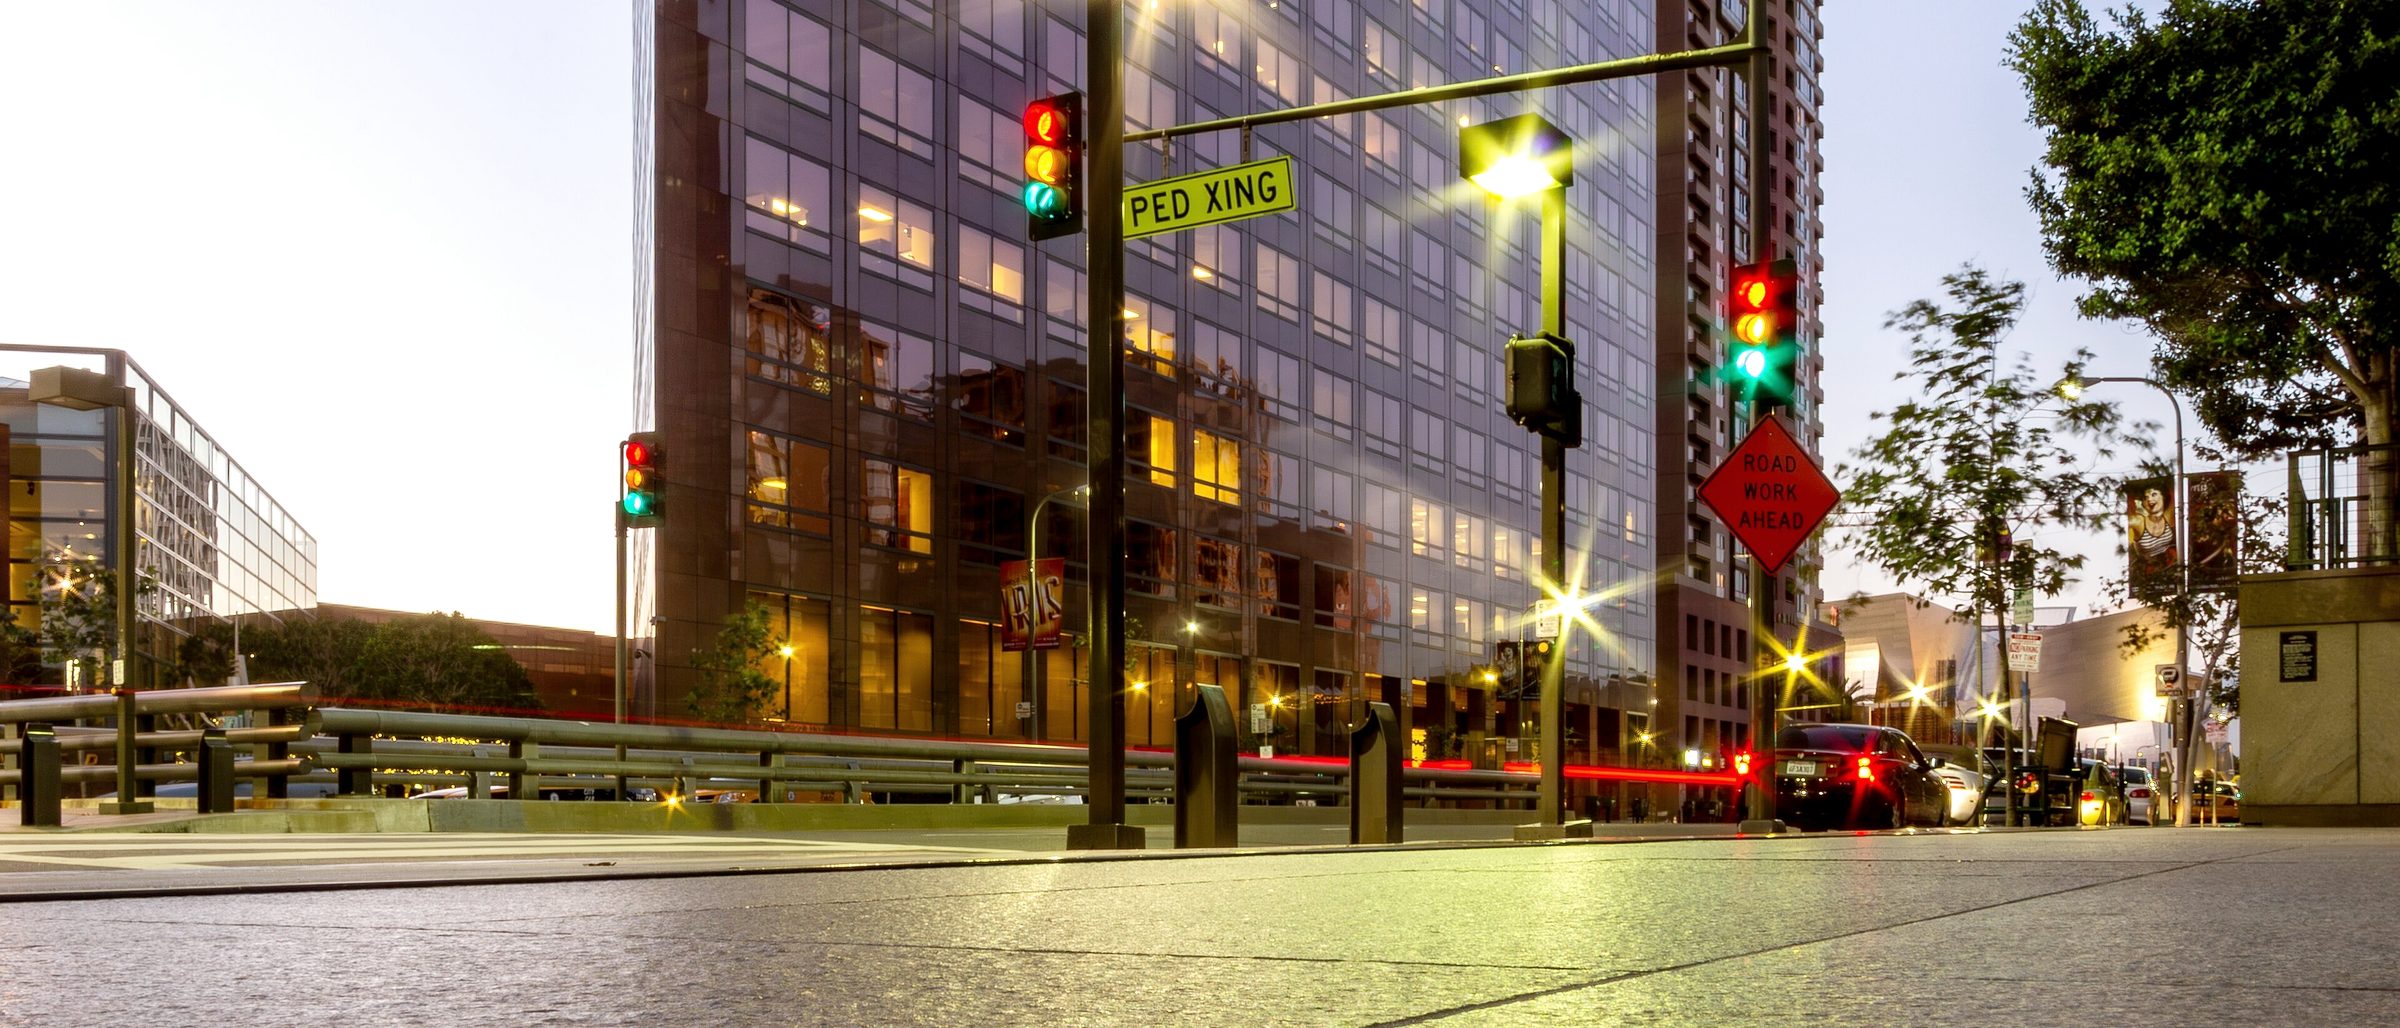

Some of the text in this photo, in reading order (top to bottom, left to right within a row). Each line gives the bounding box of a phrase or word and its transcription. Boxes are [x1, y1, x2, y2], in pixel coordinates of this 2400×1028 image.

[1131, 171, 1277, 227] PED XING
[1744, 454, 1797, 473] ROAD
[1744, 482, 1797, 501] WORK
[1739, 511, 1804, 529] AHEAD
[1001, 575, 1062, 632] IRIS
